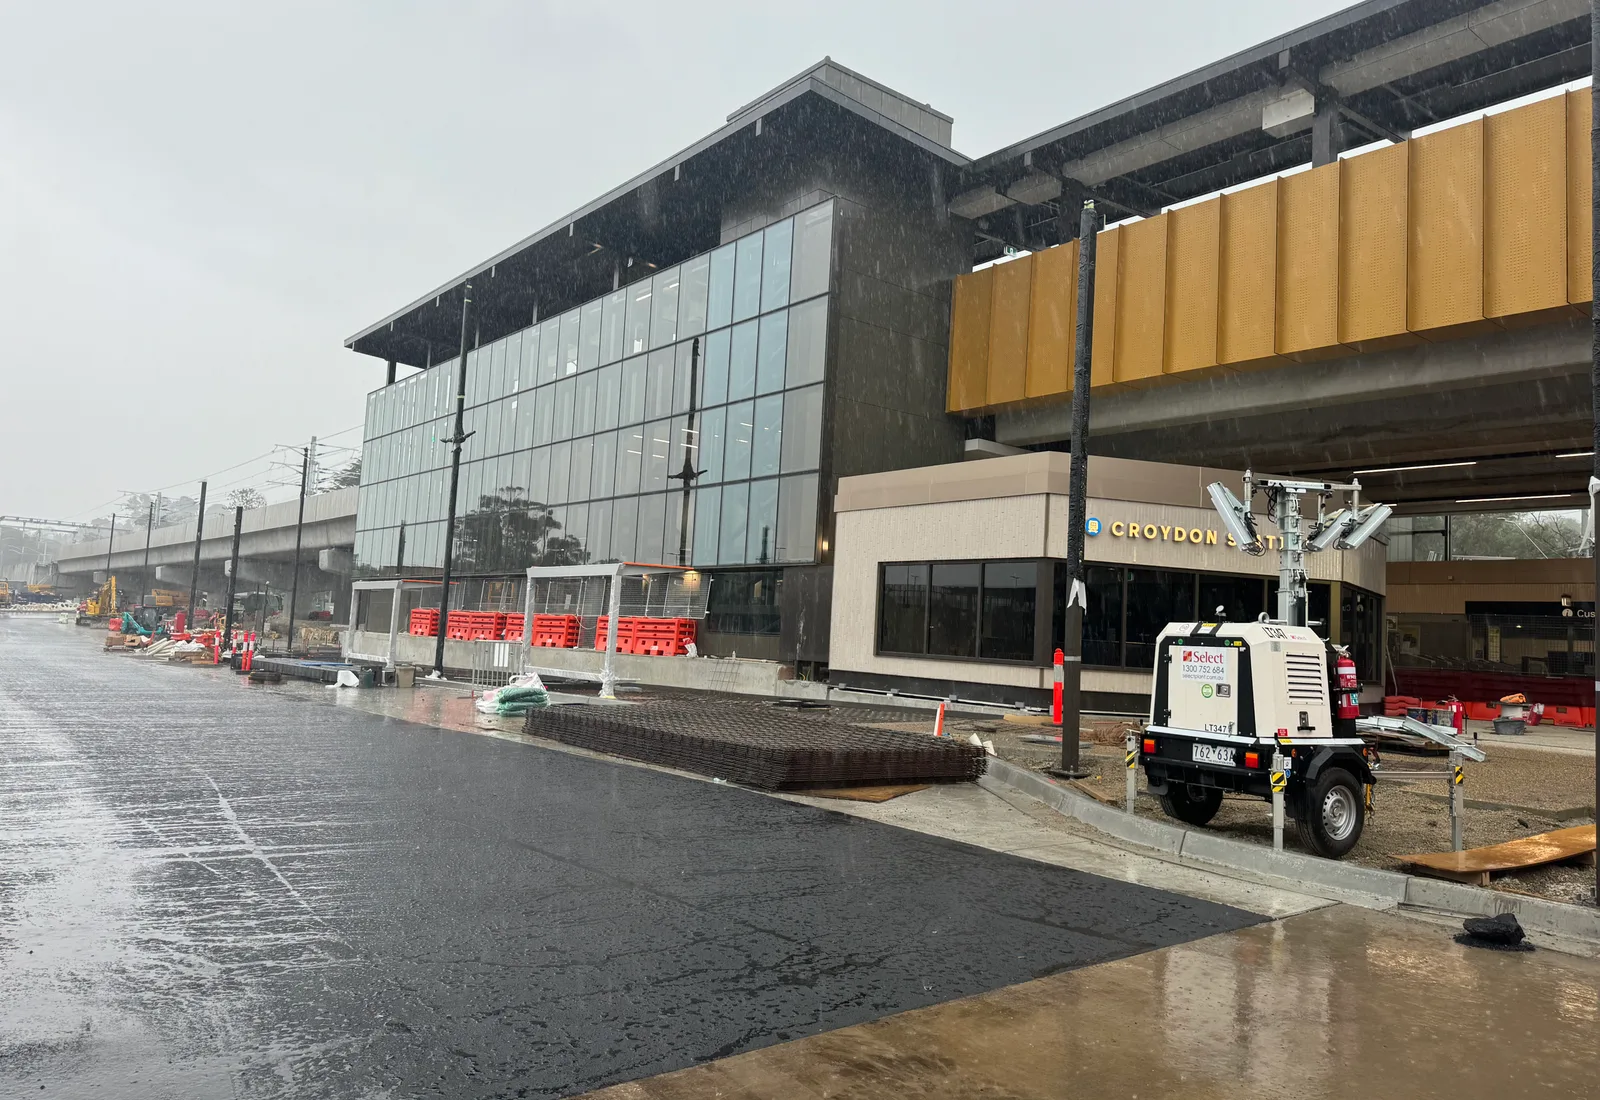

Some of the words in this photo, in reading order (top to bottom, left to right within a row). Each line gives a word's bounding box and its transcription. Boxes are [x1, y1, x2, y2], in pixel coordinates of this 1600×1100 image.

[1111, 521, 1217, 545] CROYDON
[1261, 626, 1288, 640] LT347
[1193, 650, 1224, 664] Select
[1182, 664, 1198, 673] 1300
[1198, 665, 1211, 674] 752
[1211, 666, 1225, 674] 684
[1204, 723, 1227, 733] LT347
[1194, 745, 1211, 759] 762
